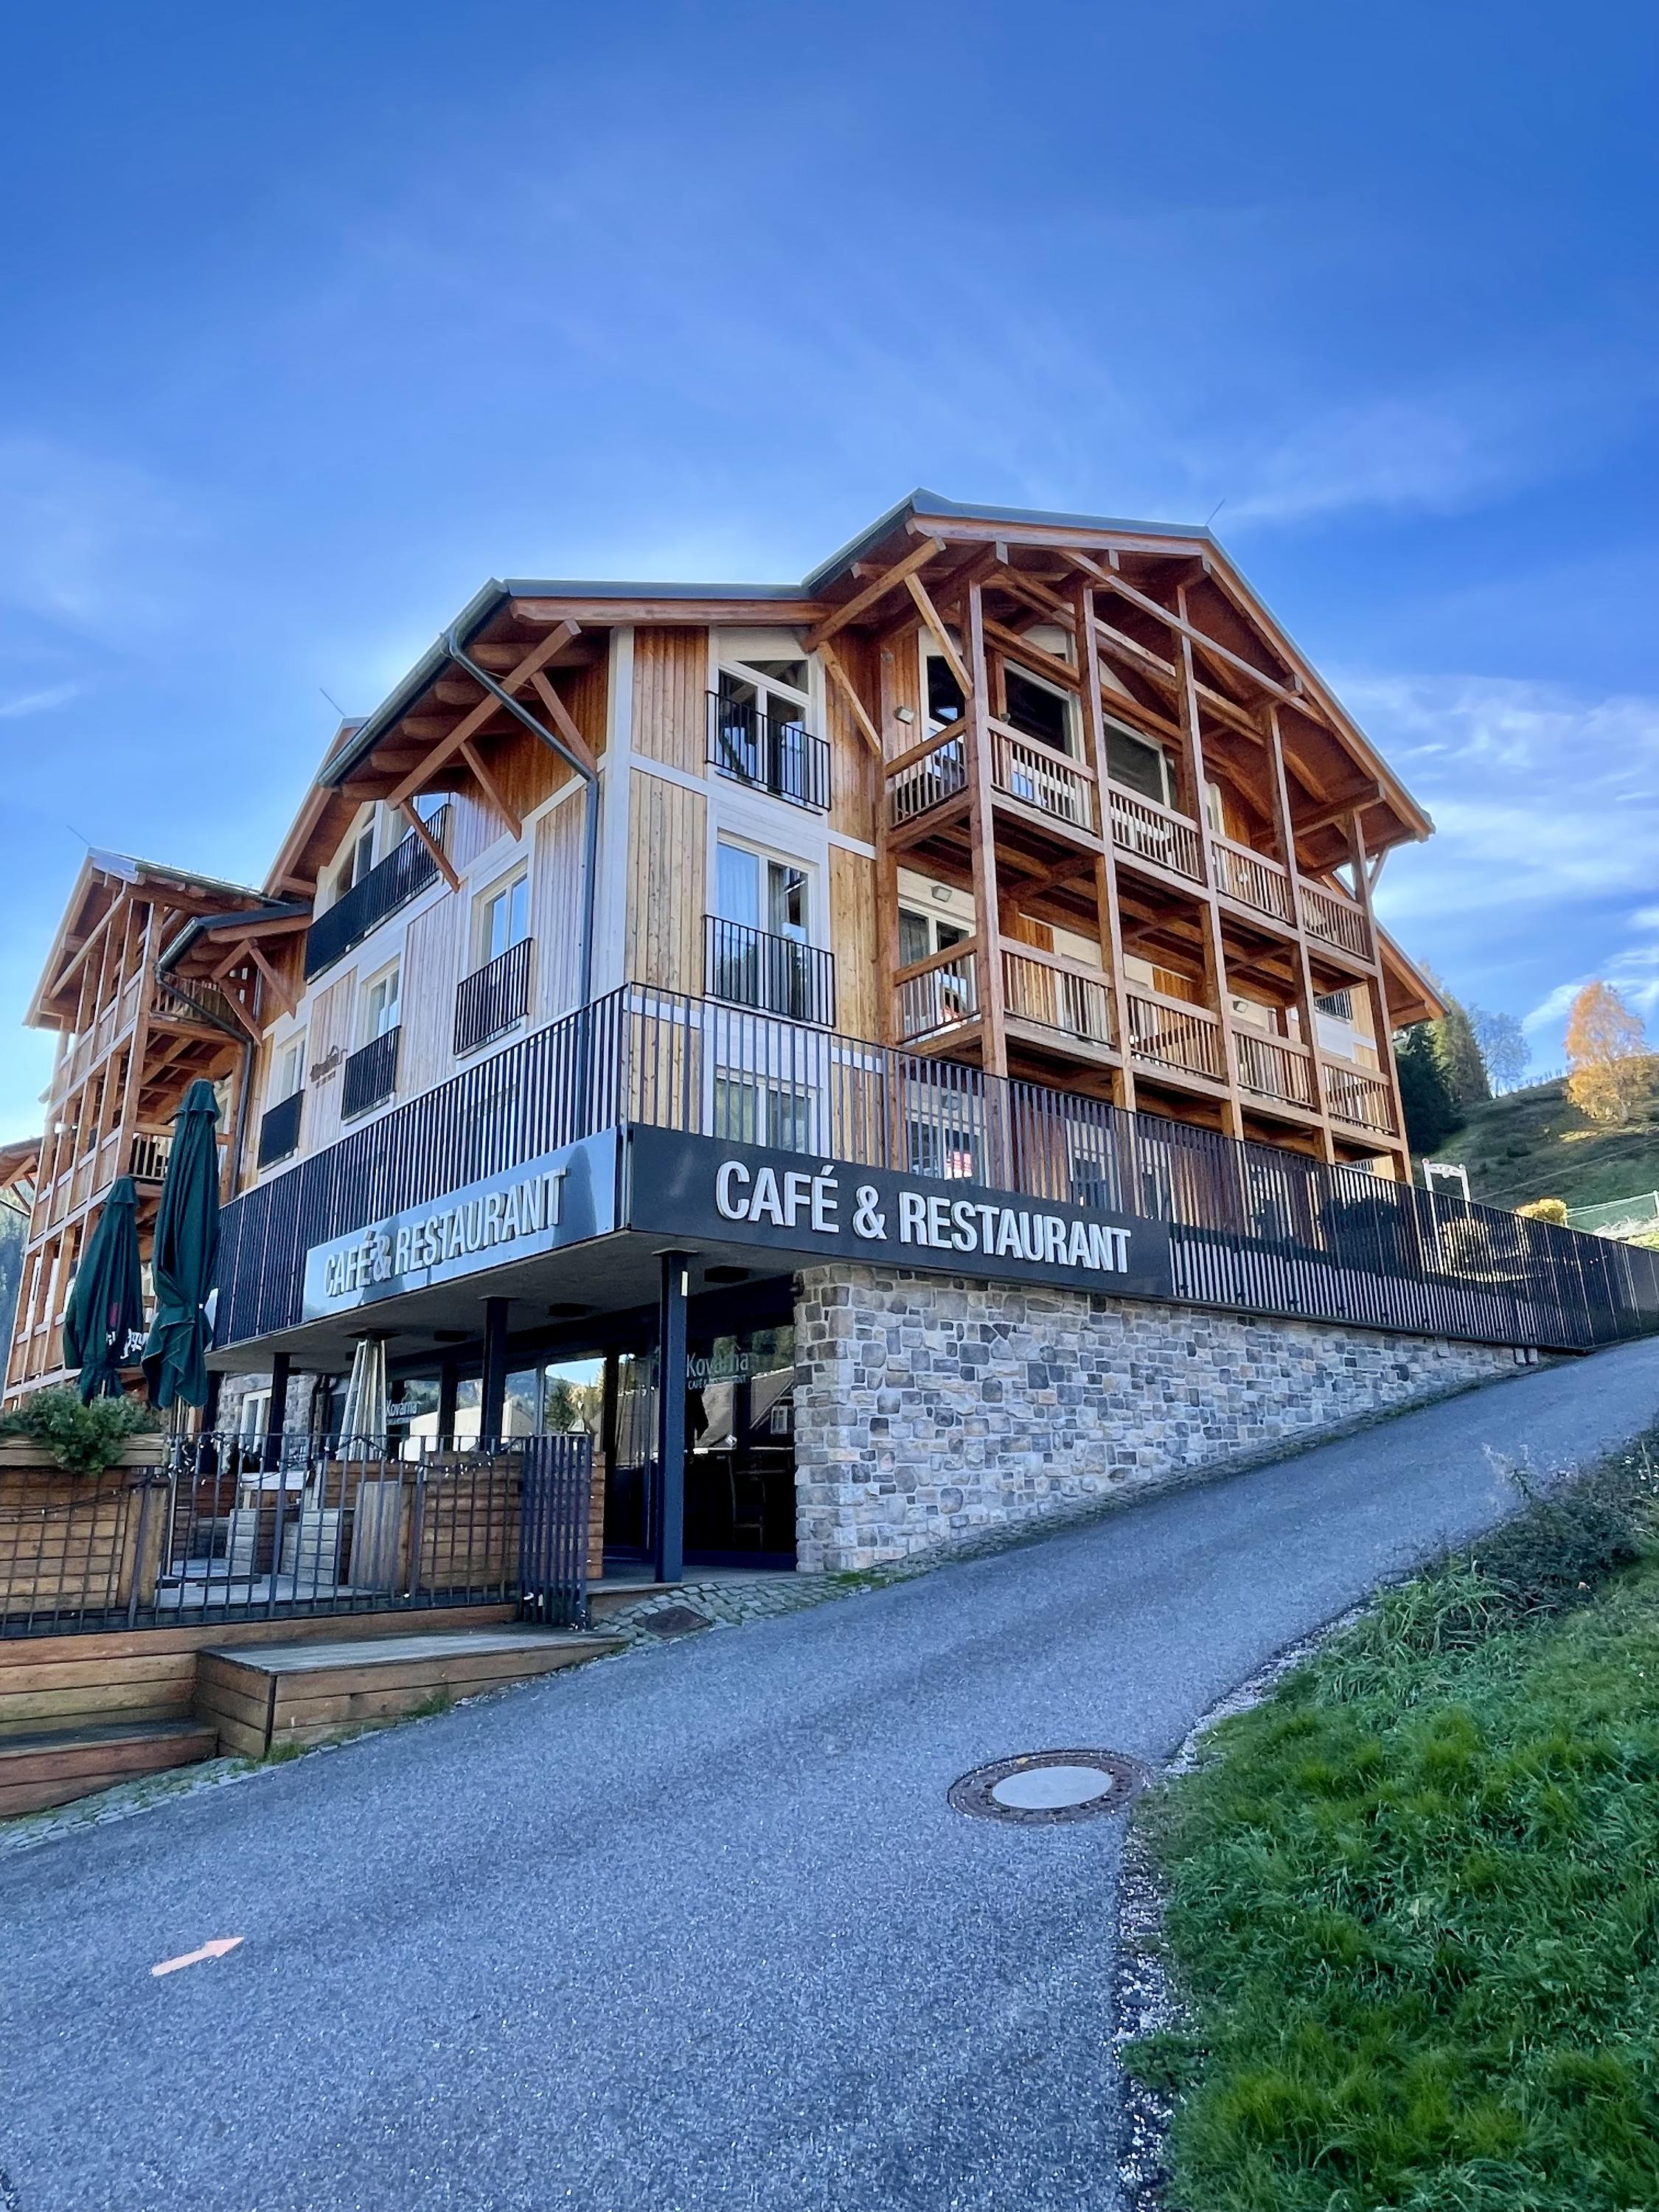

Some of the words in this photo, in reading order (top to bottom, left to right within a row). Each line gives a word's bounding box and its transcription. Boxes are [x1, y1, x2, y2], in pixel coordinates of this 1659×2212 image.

[324, 1231, 374, 1297] CAFÉ
[373, 1233, 392, 1281] &
[395, 1167, 568, 1275] RESTAURANT
[715, 1161, 839, 1233] CAFÉ
[852, 1184, 887, 1240] &
[899, 1191, 1131, 1273] RESTAURANT
